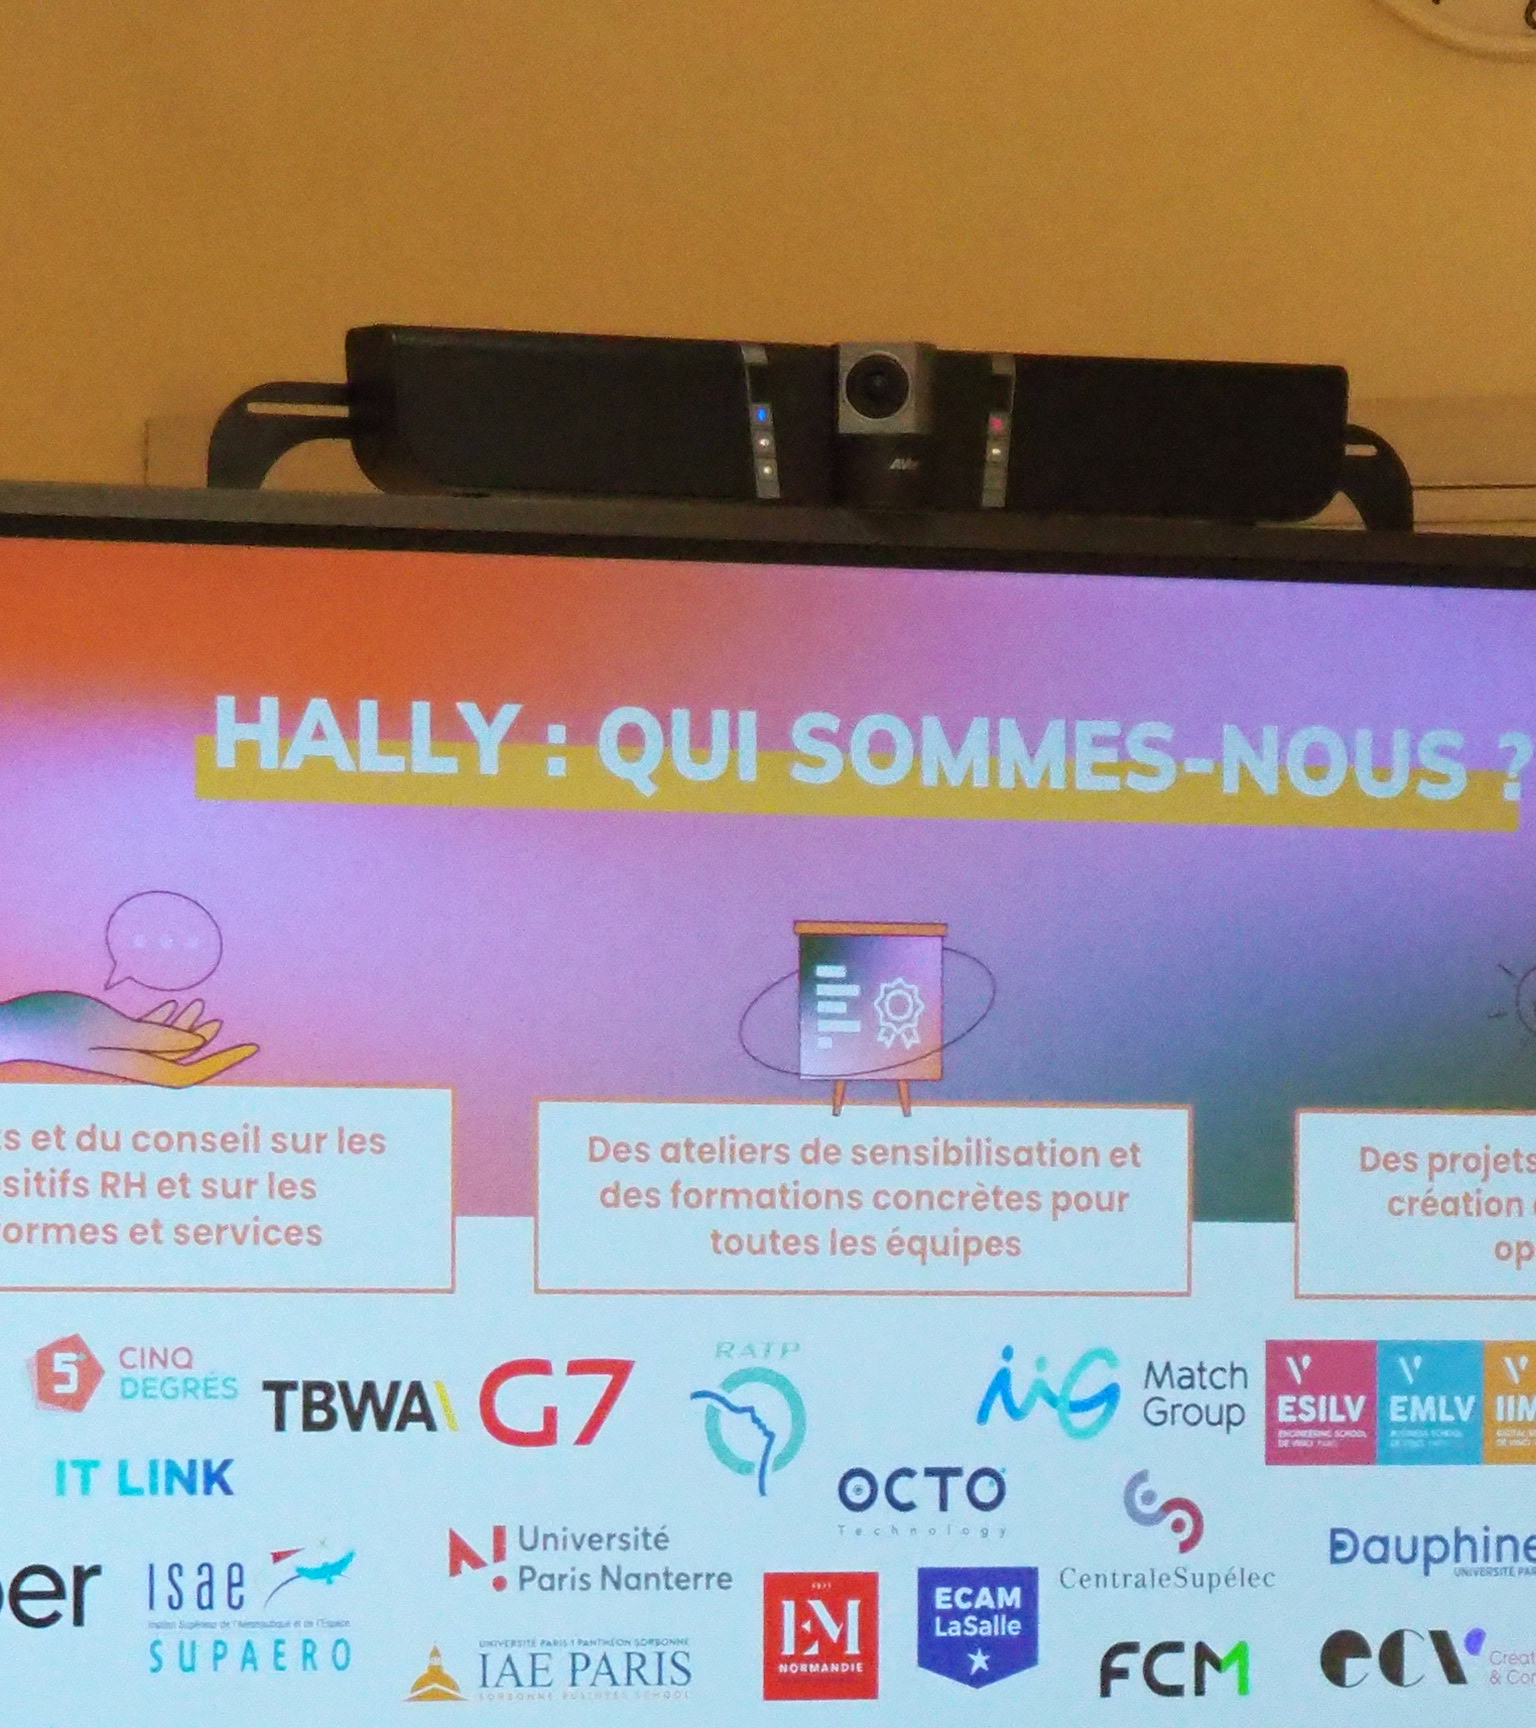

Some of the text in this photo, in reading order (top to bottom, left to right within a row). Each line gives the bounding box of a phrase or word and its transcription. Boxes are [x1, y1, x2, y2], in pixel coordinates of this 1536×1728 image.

[214, 695, 521, 776] HALLY
[597, 705, 760, 797] QUI
[791, 711, 1469, 802] SOMMES-NOUS
[1498, 731, 1535, 801] ?
[32, 1126, 66, 1152] et
[76, 1122, 121, 1153] du
[131, 1122, 261, 1154] conseil
[271, 1130, 326, 1155] sur
[338, 1126, 386, 1156] les
[588, 1134, 1142, 1169] Des ateliers de sensibilisation et
[1360, 1145, 1418, 1173] Des
[100, 1171, 147, 1199] RH
[157, 1173, 191, 1200] et
[202, 1176, 256, 1200] sur
[268, 1171, 317, 1201] les
[599, 1180, 1130, 1221] des formations concrètes pour
[1387, 1188, 1523, 1219] création
[128, 1218, 163, 1246] et
[173, 1218, 323, 1247] services
[710, 1227, 1022, 1266] toutes les équipes
[119, 1346, 194, 1370] CINQ
[715, 1341, 801, 1360] RATP
[120, 1370, 239, 1400] DEGRÉS
[1144, 1360, 1249, 1390] Match
[479, 1358, 636, 1447] G7
[1143, 1396, 1246, 1435] Group
[1277, 1395, 1367, 1423] ESILV
[1389, 1395, 1476, 1423] EMLV
[55, 1458, 235, 1496] IT LINK
[838, 1467, 1007, 1512] OCTO
[518, 1522, 670, 1553] Université
[838, 1523, 1008, 1540] Technology
[519, 1564, 734, 1592] Paris Nanterre
[1059, 1566, 1277, 1591] CentraleSupélec
[935, 1587, 1022, 1610] ECAM
[935, 1613, 1022, 1637] LaSalle
[149, 1636, 352, 1674] SUPAERO
[478, 1651, 693, 1688] IAE PARIS
[778, 1663, 864, 1673] NORMANDIE
[1099, 1640, 1251, 1698] FCM
[1489, 1669, 1502, 1685] &
